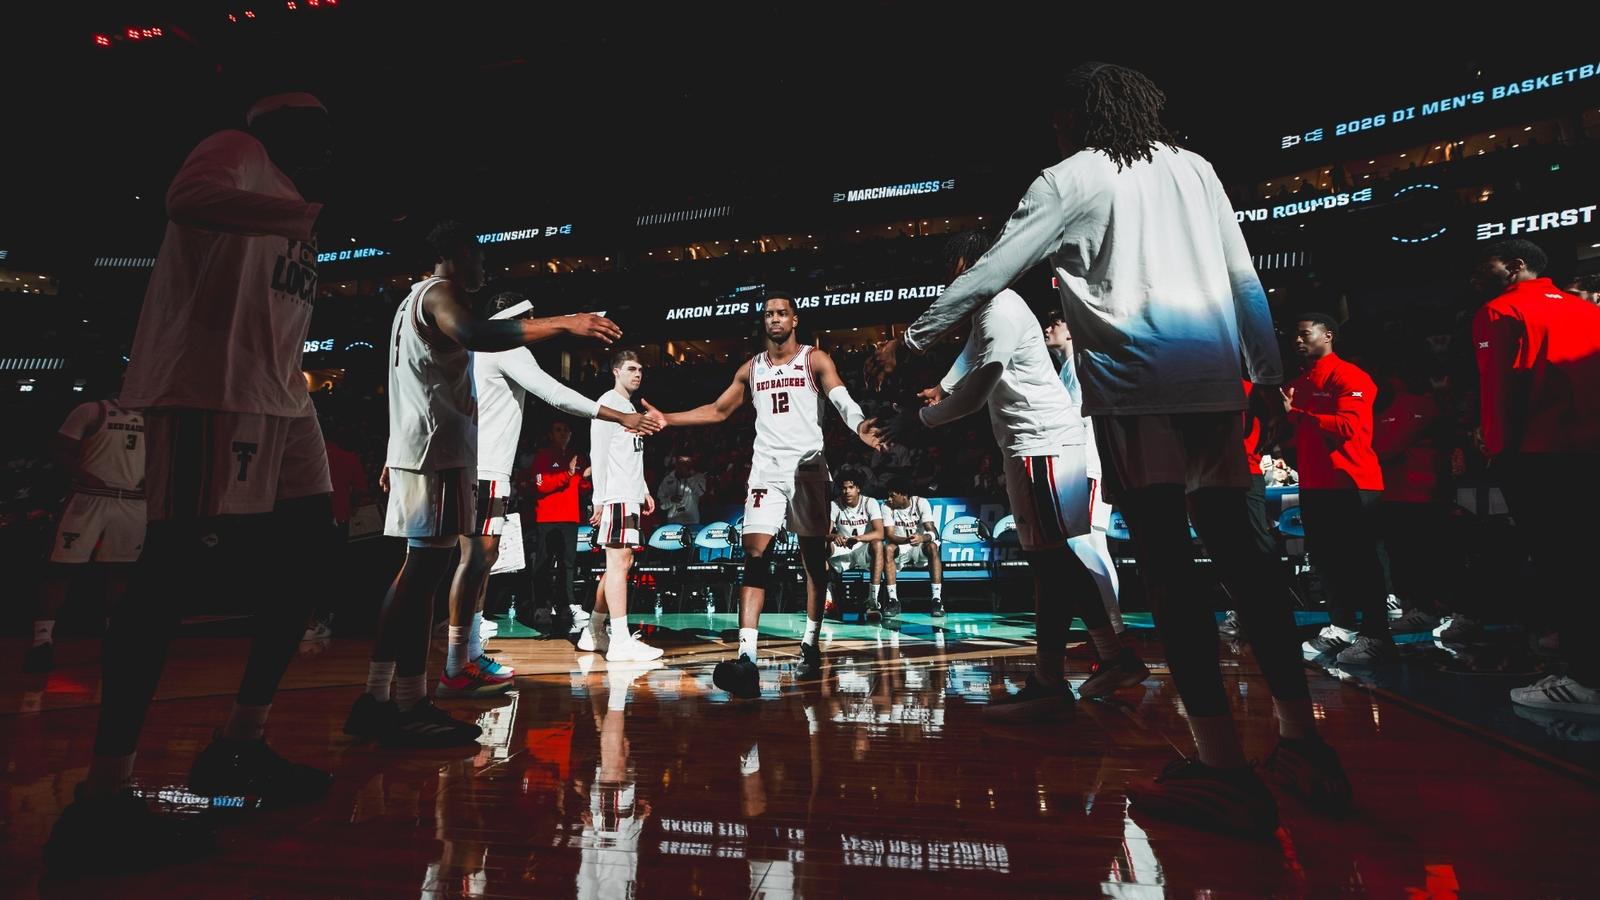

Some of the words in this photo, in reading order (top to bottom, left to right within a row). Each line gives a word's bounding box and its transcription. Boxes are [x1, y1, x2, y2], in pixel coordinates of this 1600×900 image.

[1335, 115, 1386, 137] 2026
[1392, 107, 1416, 123] DI
[1421, 91, 1485, 116] MEN'S
[1491, 62, 1600, 100] BASKETB
[1510, 205, 1597, 235] FIRST
[665, 305, 713, 321] AKRON
[715, 302, 750, 316] ZIPS
[823, 292, 861, 307] TECH
[864, 288, 894, 303] RED
[757, 381, 770, 391] RED
[770, 378, 805, 389] RAIDERS
[771, 392, 789, 414] 12
[107, 422, 125, 432] RED
[125, 434, 138, 450] 3
